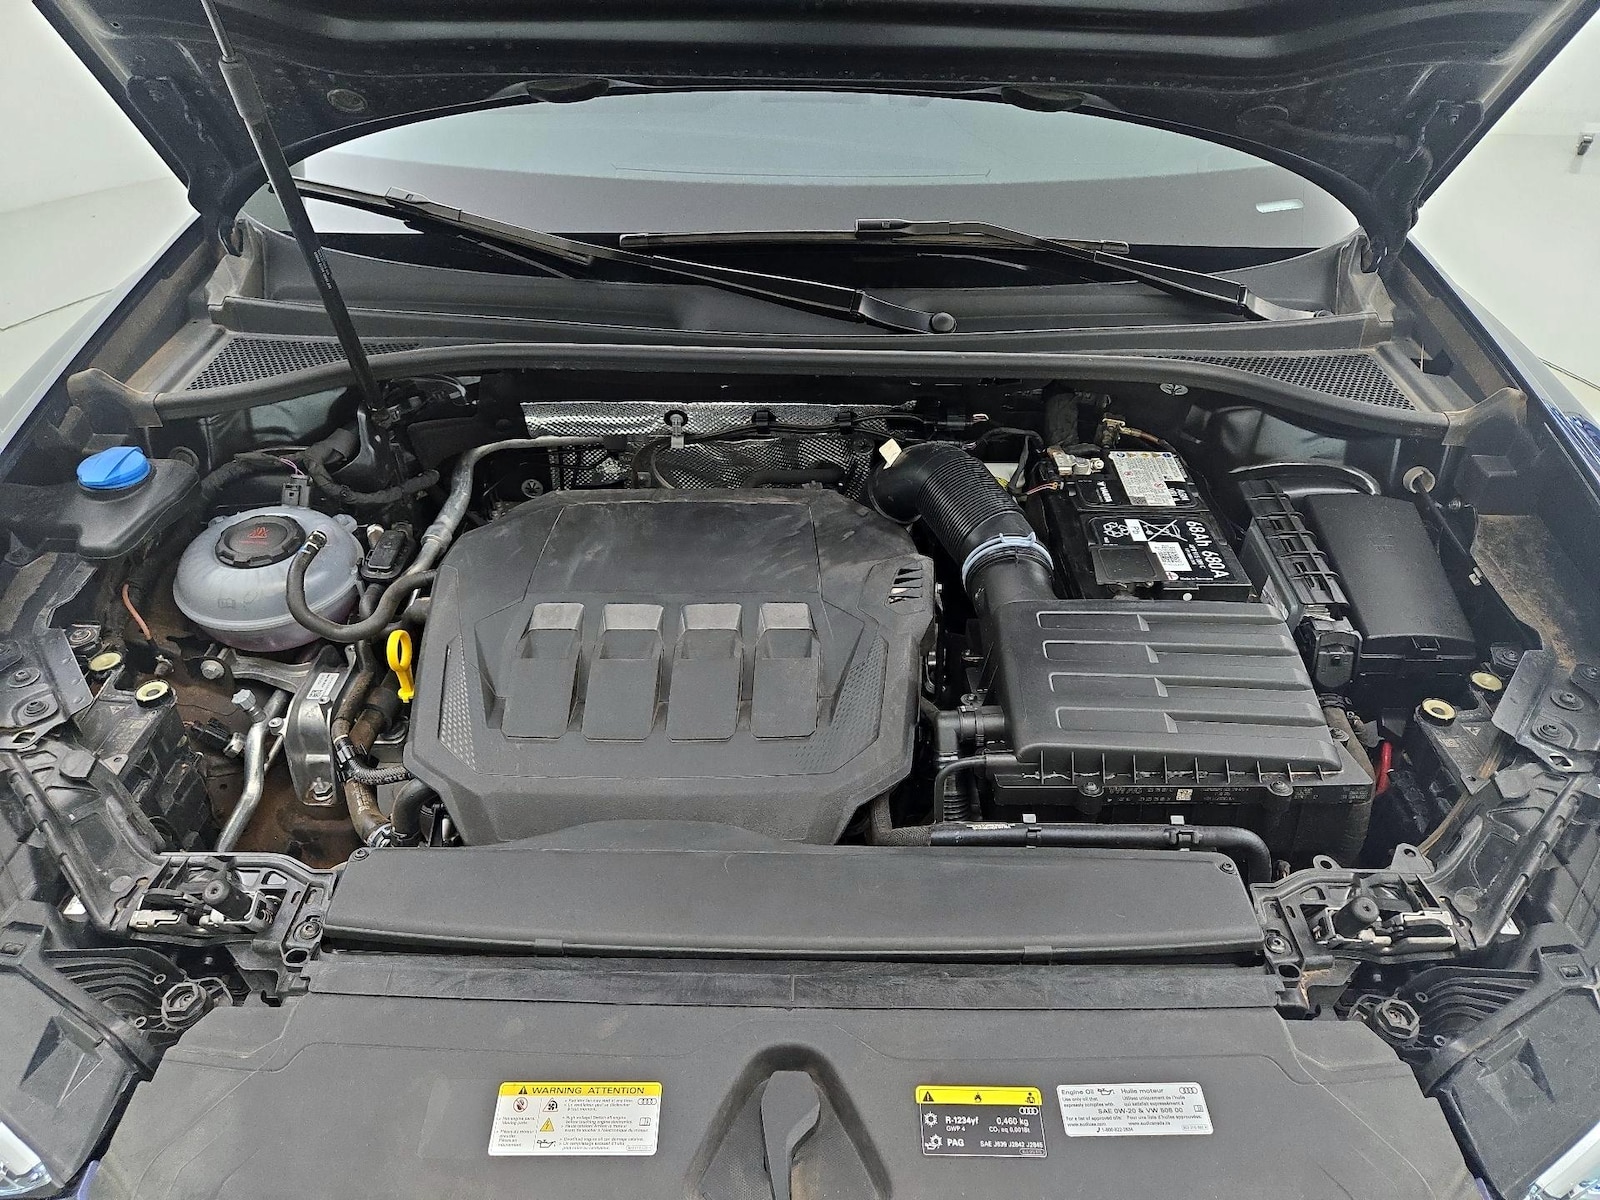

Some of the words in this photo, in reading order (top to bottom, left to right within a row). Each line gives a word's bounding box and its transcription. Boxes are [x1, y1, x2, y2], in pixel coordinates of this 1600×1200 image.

[1185, 521, 1212, 546] 68Ah
[1201, 550, 1230, 578] 680A
[945, 1116, 979, 1126] R-1234yf
[996, 1117, 1018, 1126] 0,460
[1019, 1118, 1030, 1126] kg
[947, 1138, 965, 1147] PAG
